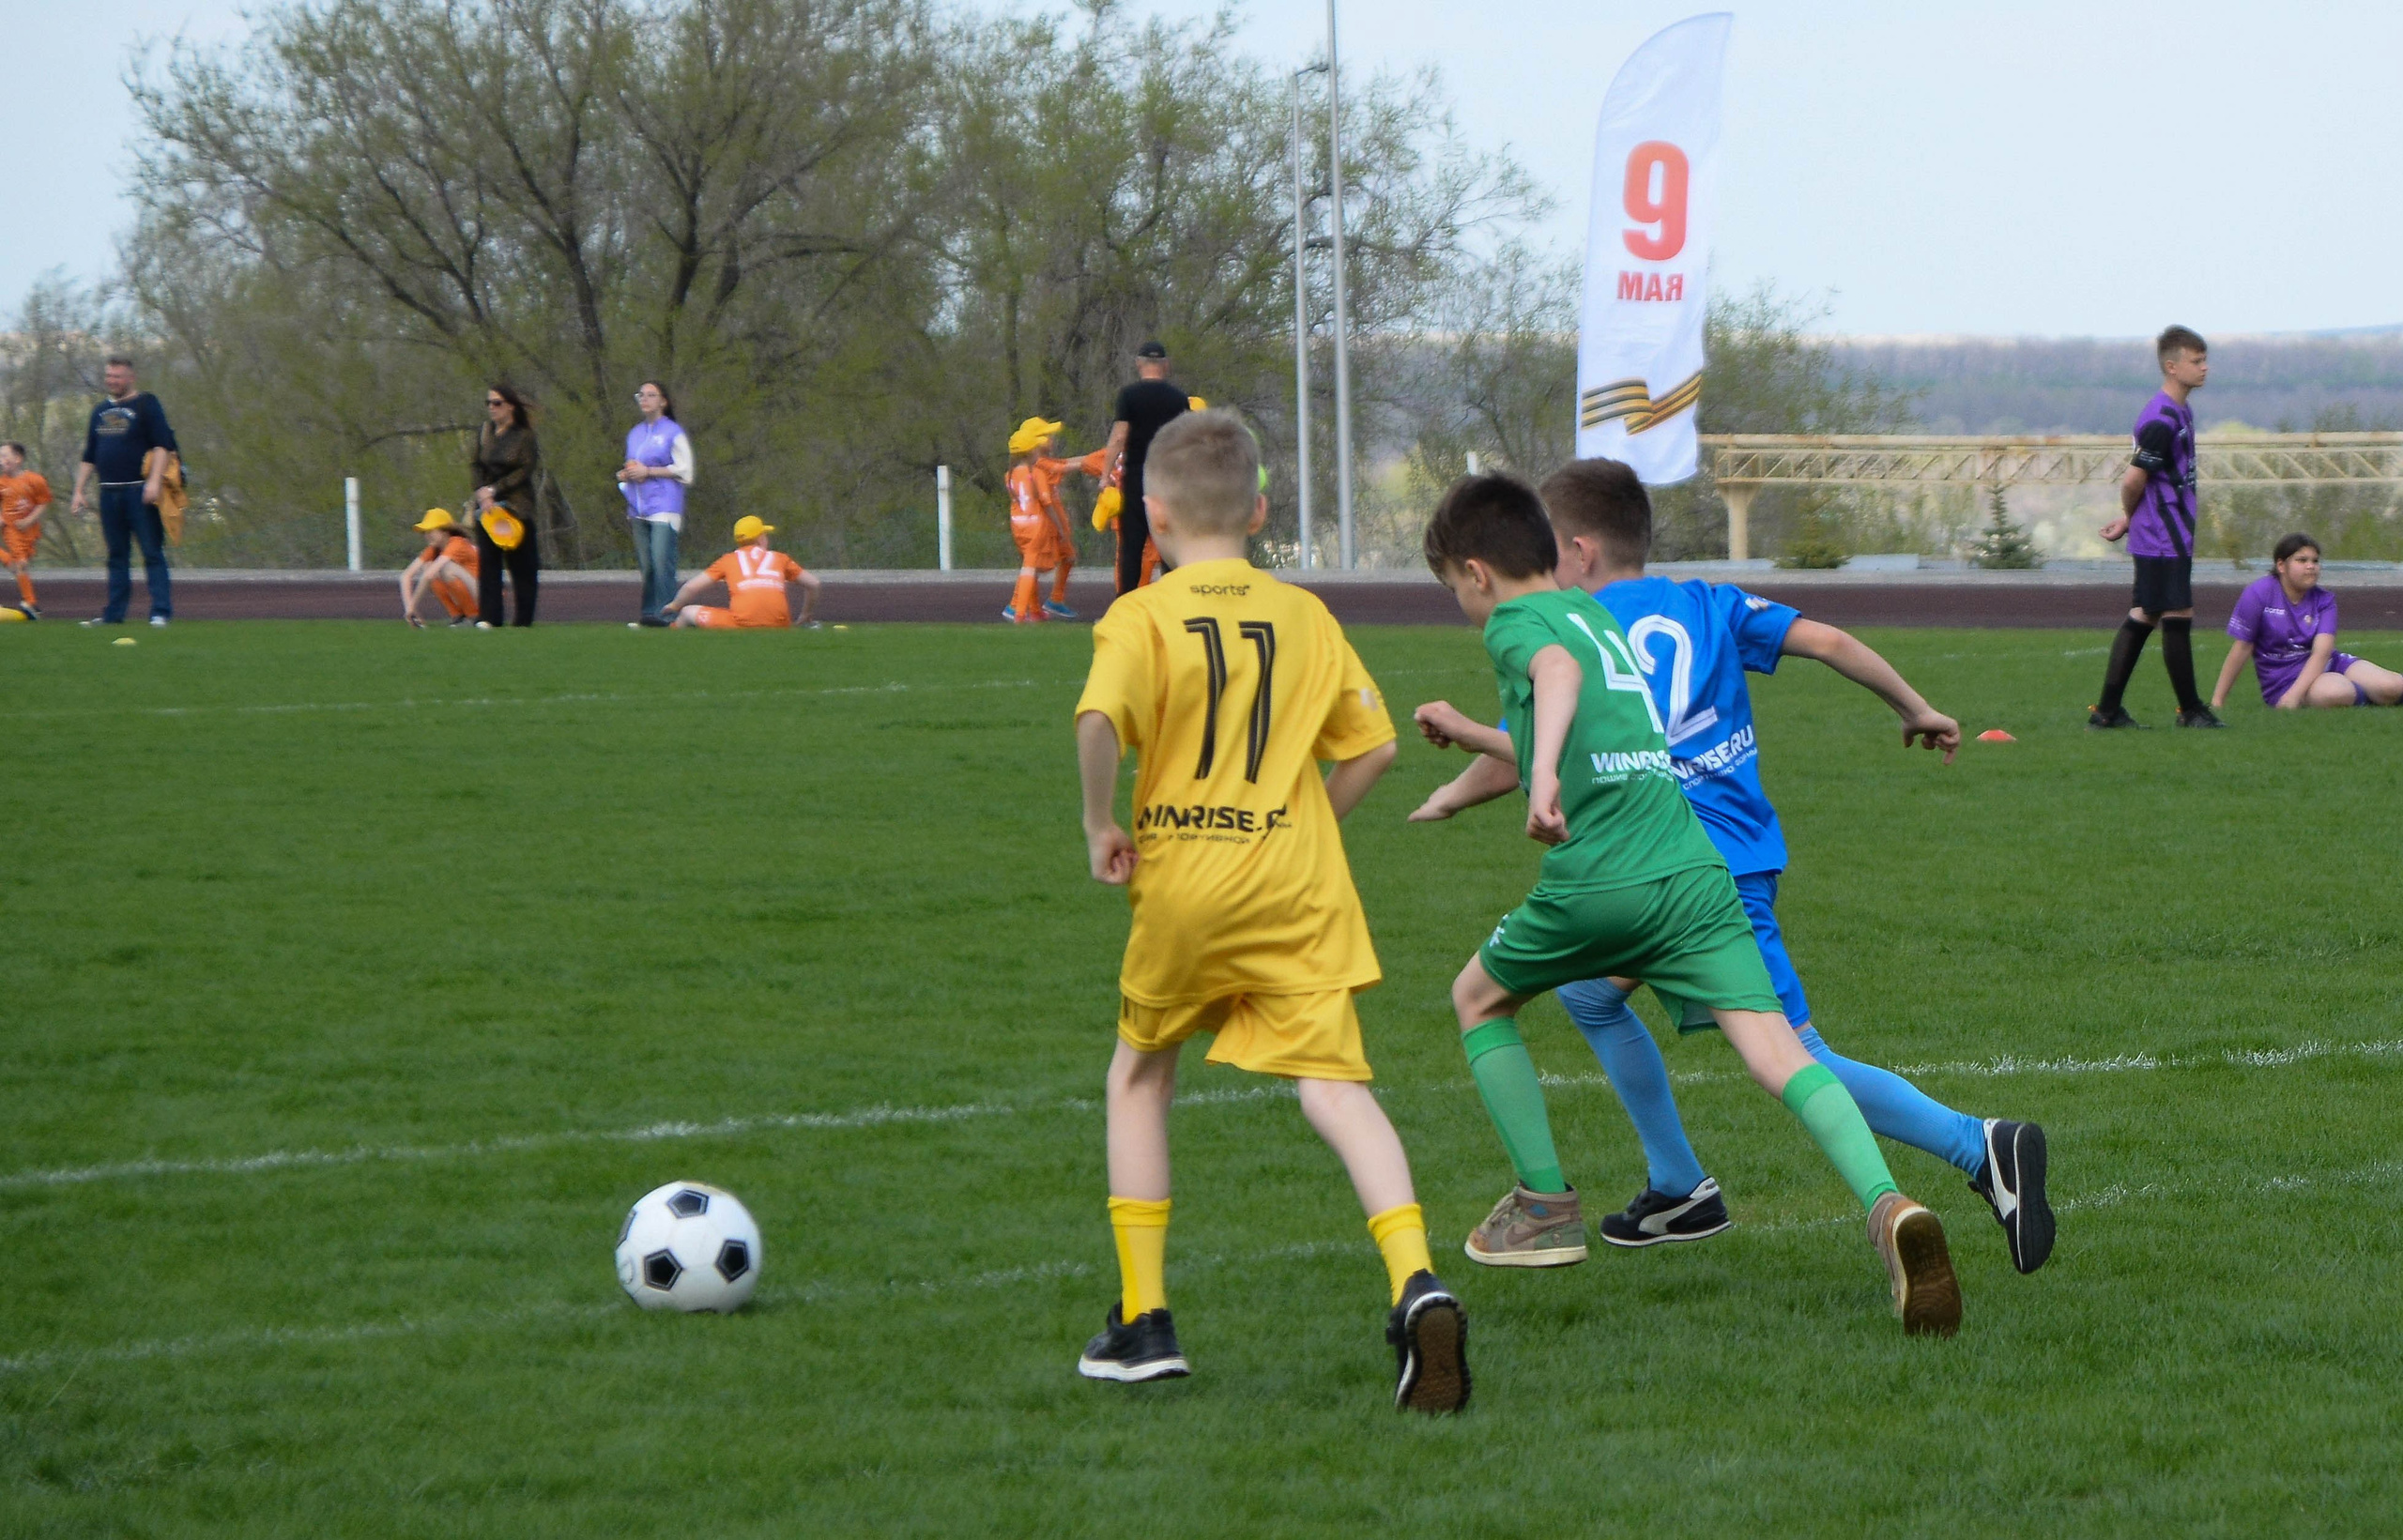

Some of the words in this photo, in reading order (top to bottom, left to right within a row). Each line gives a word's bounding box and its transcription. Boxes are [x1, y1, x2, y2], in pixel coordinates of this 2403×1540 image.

[1622, 140, 1689, 261] 9
[1616, 271, 1684, 302] МАЯ
[734, 546, 780, 576] 12
[1182, 616, 1277, 785] 11
[1566, 613, 1665, 734] 4
[1627, 614, 1719, 748] 2
[1670, 724, 1754, 780] NRISE.RU
